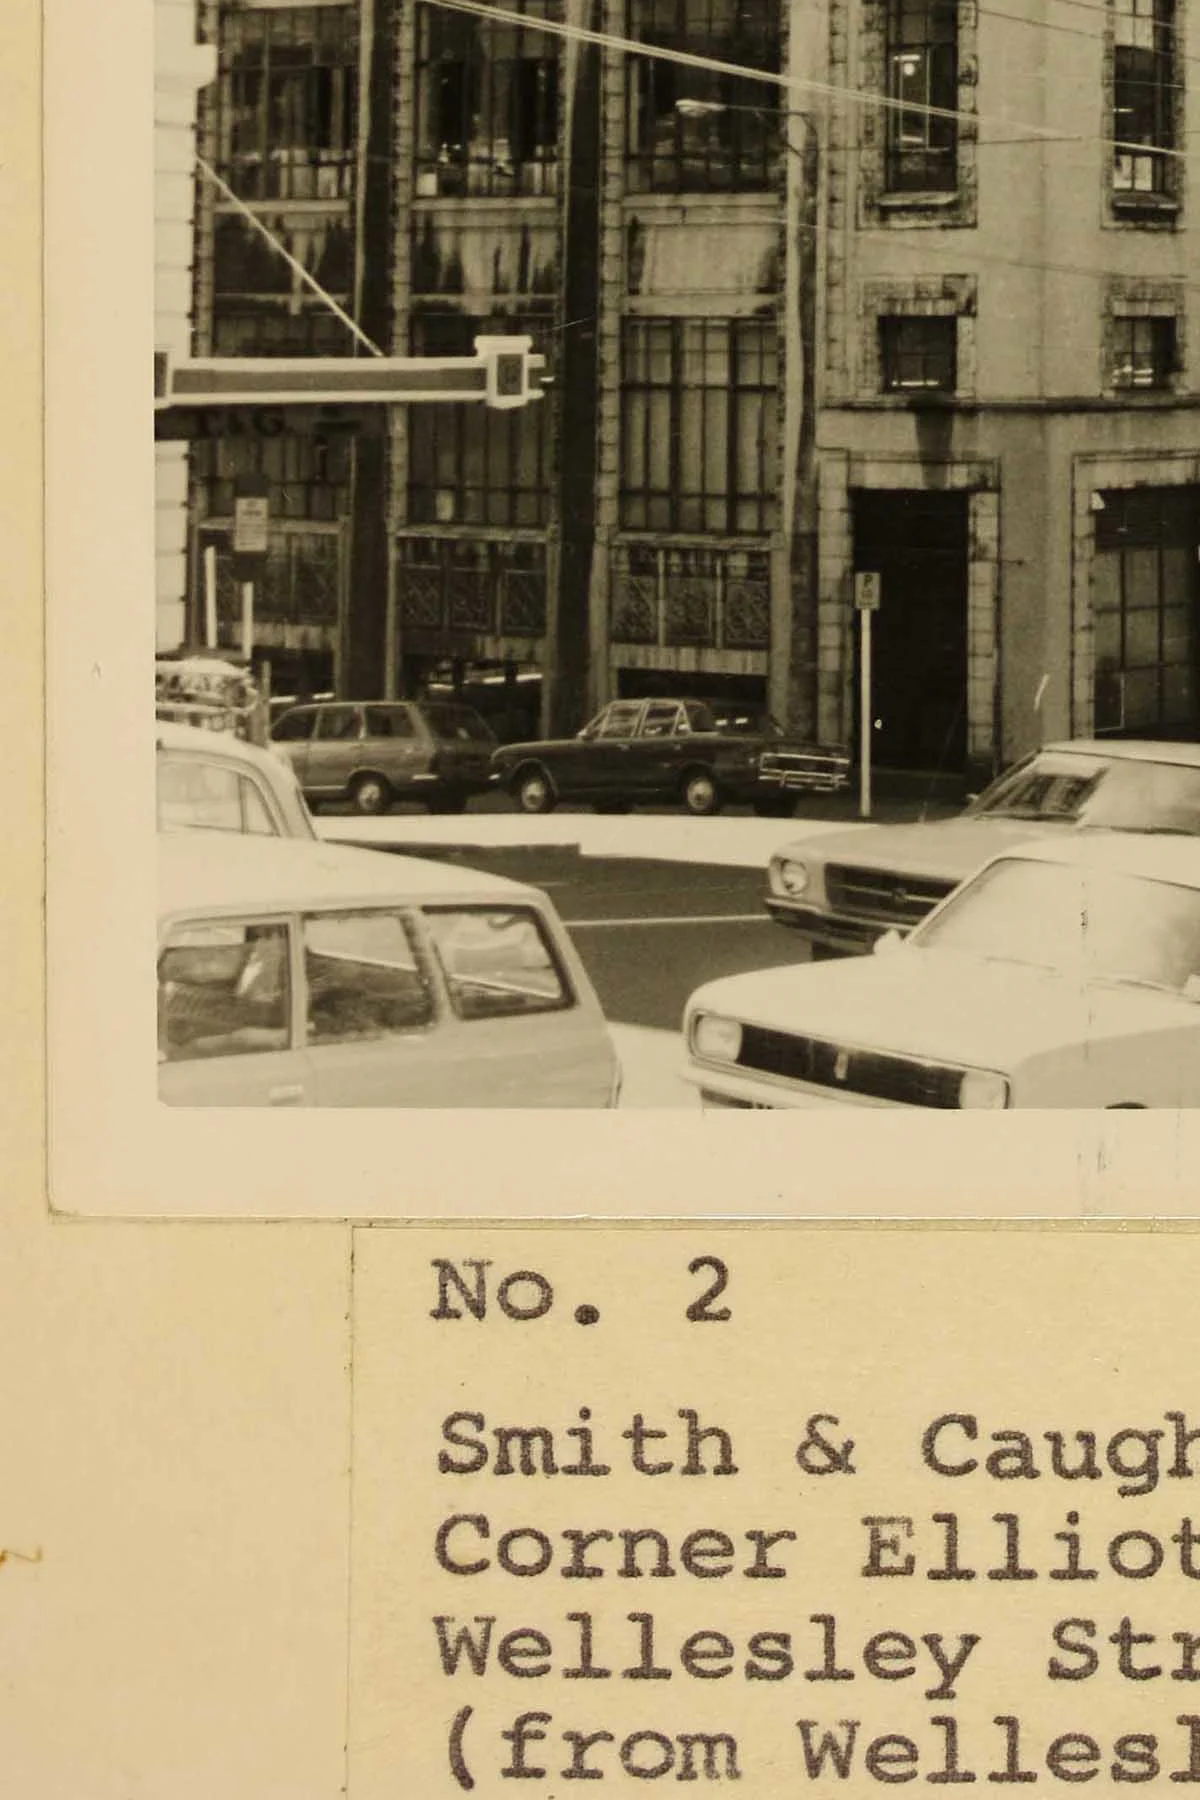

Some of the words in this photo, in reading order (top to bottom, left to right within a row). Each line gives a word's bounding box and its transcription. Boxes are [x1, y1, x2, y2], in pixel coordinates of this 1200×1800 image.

[431, 1260, 602, 1327] No.
[686, 1257, 733, 1323] 2
[440, 1410, 739, 1478] Smith
[797, 1414, 857, 1477] &
[436, 1516, 798, 1581] Corner
[434, 1613, 983, 1702] Wellesley
[449, 1707, 742, 1792] (from
